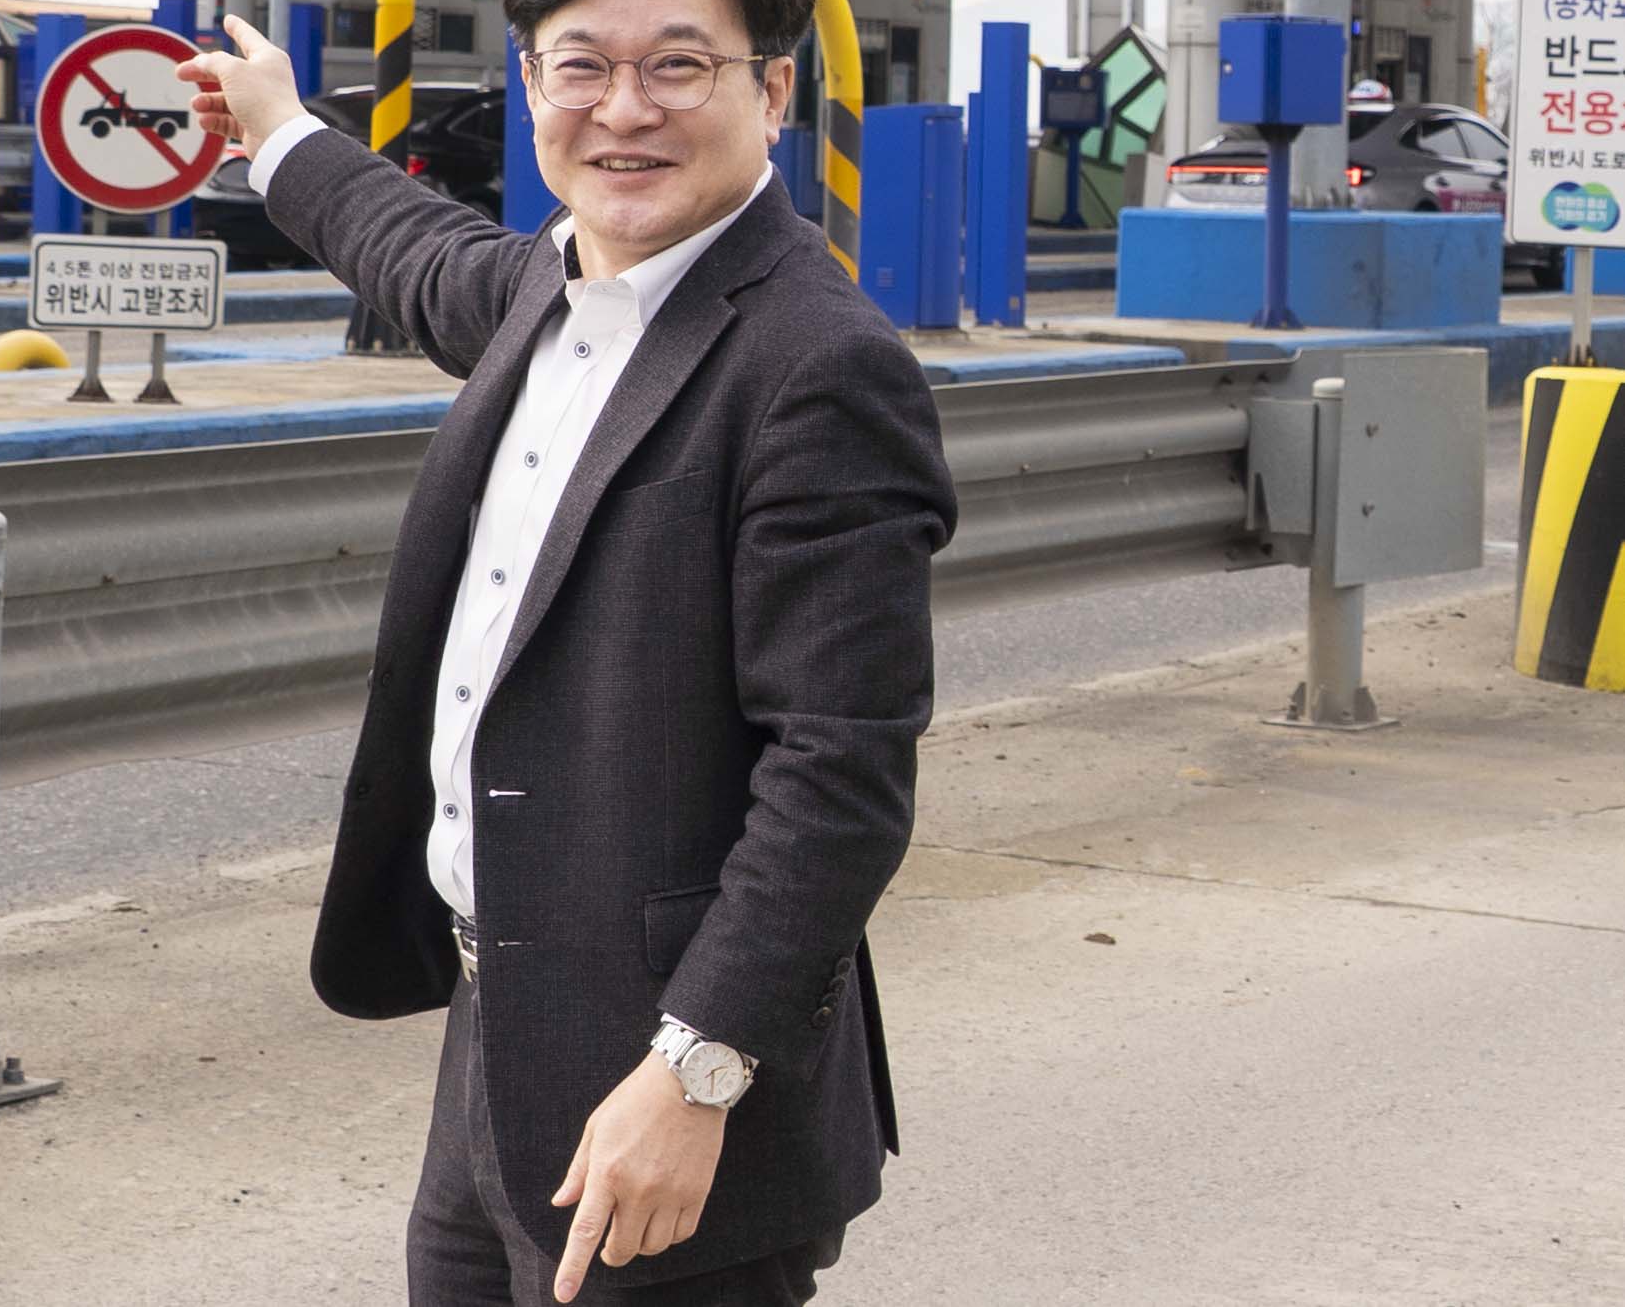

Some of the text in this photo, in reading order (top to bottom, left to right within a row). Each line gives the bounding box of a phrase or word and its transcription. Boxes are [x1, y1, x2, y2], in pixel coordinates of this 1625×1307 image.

[1546, 36, 1625, 78] 반드
[1540, 90, 1625, 135] 전용
[99, 261, 133, 279] 이상
[45, 282, 209, 316] 위반시 고발조치
